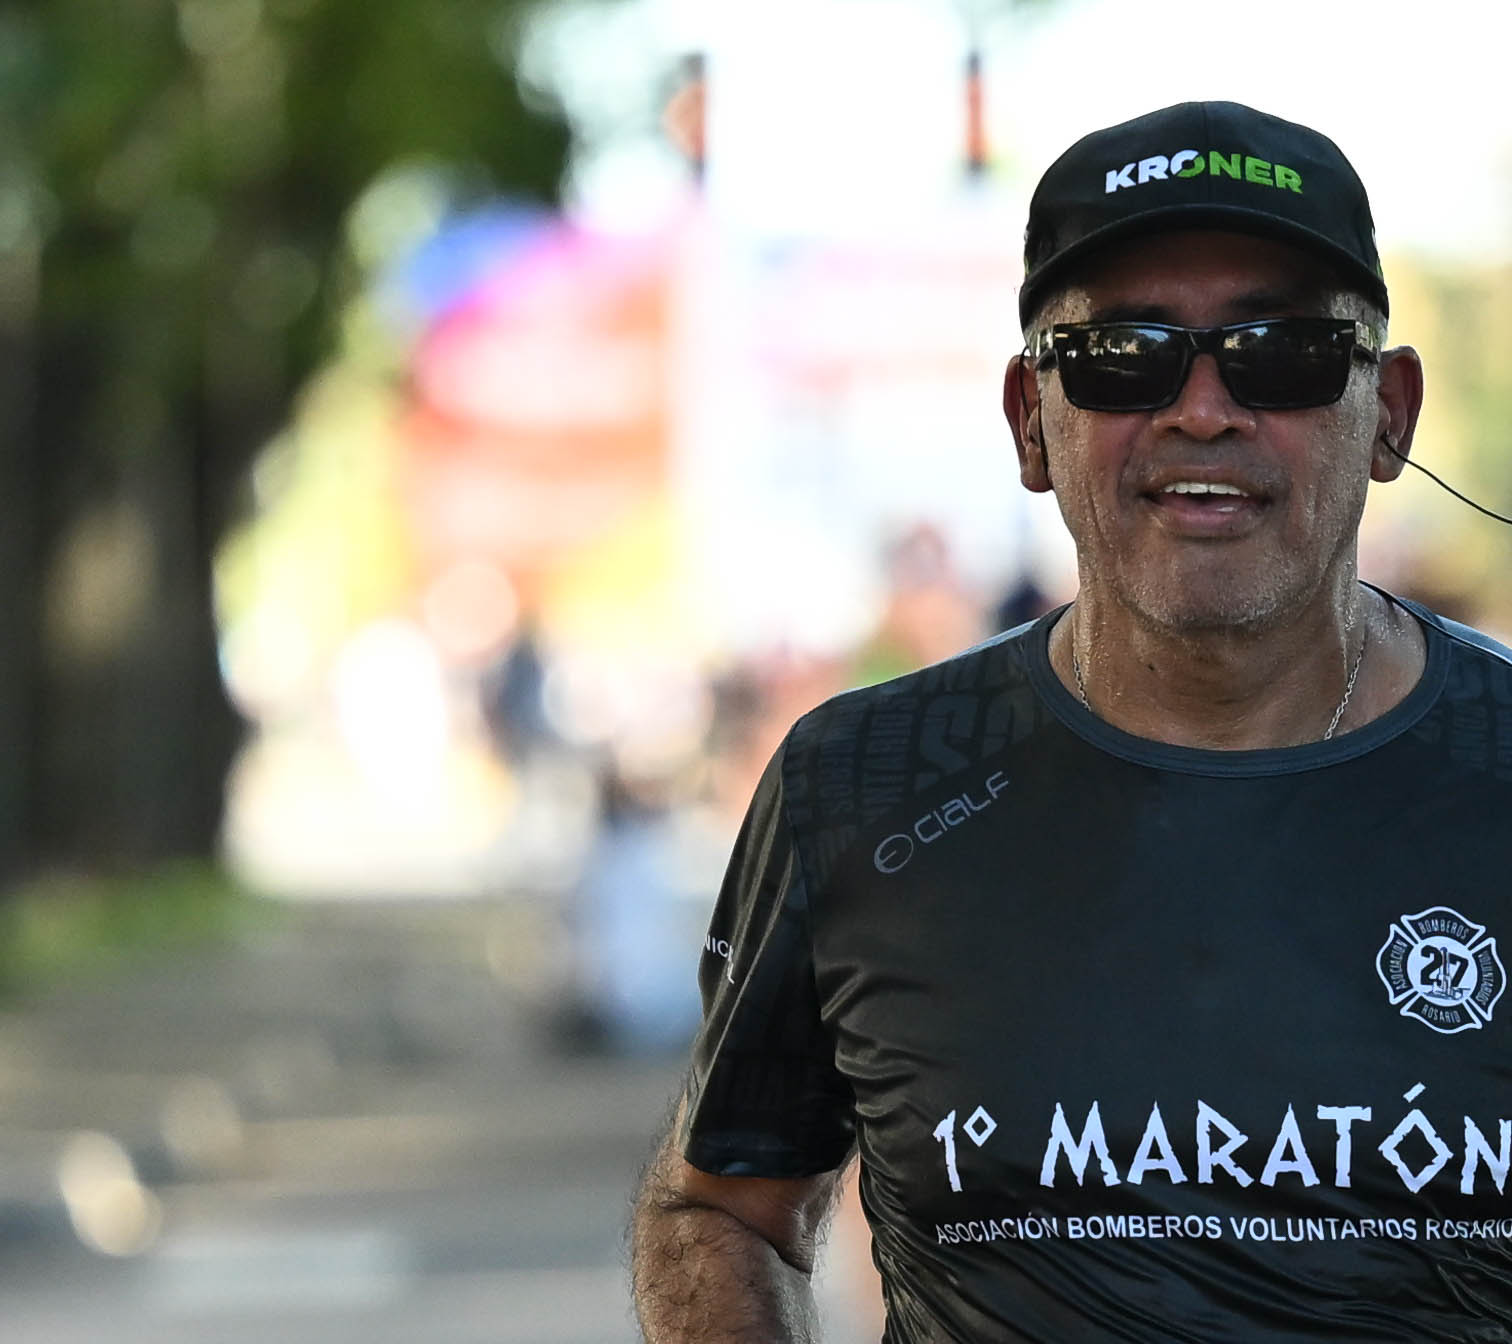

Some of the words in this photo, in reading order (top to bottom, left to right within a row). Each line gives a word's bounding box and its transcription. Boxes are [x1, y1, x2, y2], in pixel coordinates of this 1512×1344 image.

[1104, 149, 1303, 194] KRONER
[1418, 918, 1470, 940] BOMBEROS
[1419, 944, 1470, 989] 27
[1421, 1004, 1462, 1024] ROSARIO
[1039, 1082, 1512, 1197] MARATÓN
[936, 1211, 1062, 1246] ASOCIACIÓN
[1067, 1214, 1223, 1241] BOMBEROS
[1229, 1215, 1418, 1242] VOLUNTARIOS
